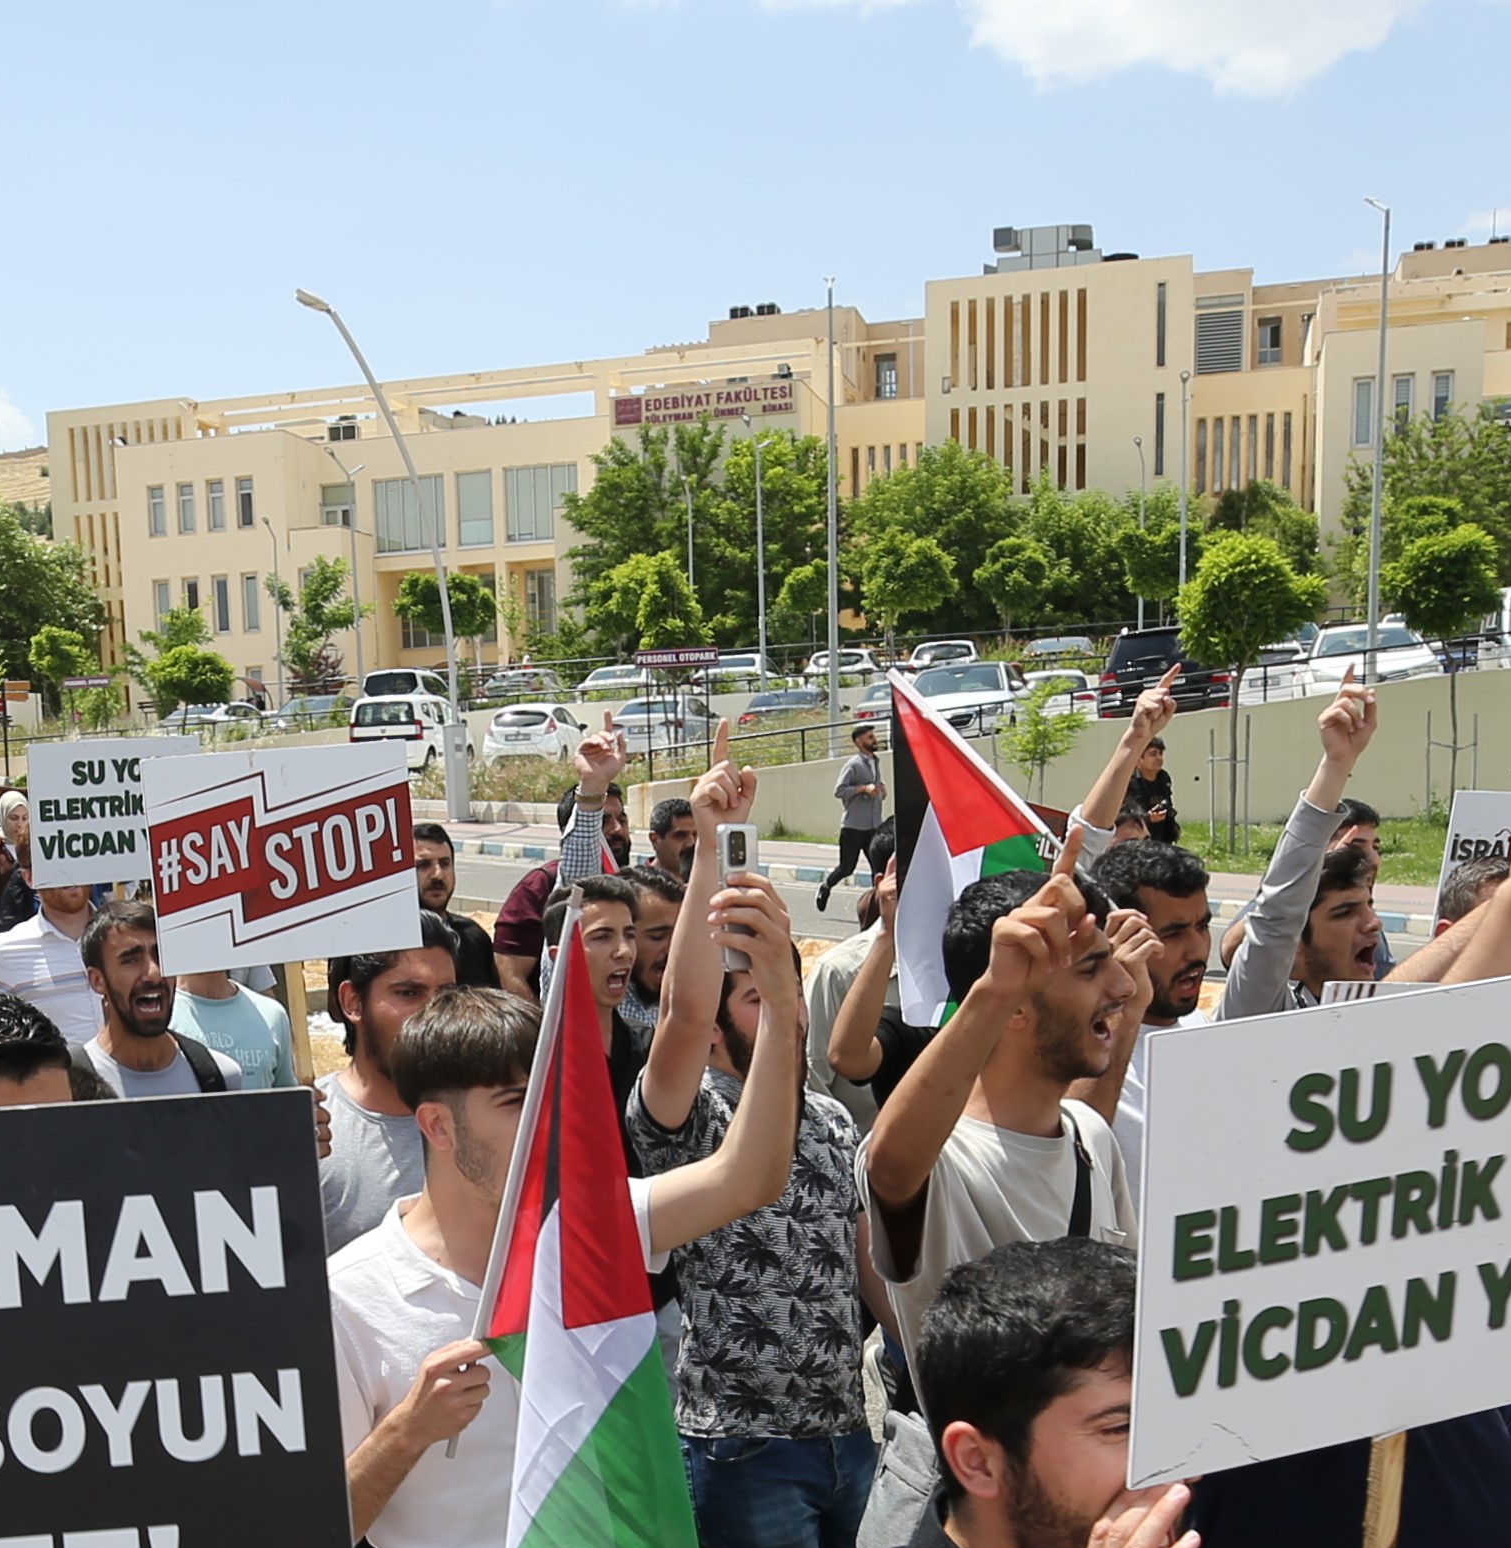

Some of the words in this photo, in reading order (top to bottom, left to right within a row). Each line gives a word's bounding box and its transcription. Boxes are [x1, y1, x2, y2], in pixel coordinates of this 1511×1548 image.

[645, 393, 712, 412] EDEBİYAT
[717, 383, 793, 406] FAKÜLTESİ
[762, 402, 793, 413] BİNASI
[637, 653, 677, 664] PERSONEL
[679, 651, 716, 662] OTOPARK
[72, 758, 106, 786] SU
[111, 757, 141, 784] YO
[39, 789, 145, 822] ELEKTRİK
[38, 828, 136, 860] VİCDAN
[157, 815, 251, 894] #SAY
[264, 797, 403, 900] STOP!
[1284, 1062, 1393, 1153] SU
[1172, 1149, 1506, 1282] ELEKTRİK
[1160, 1270, 1457, 1398] VİCDAN
